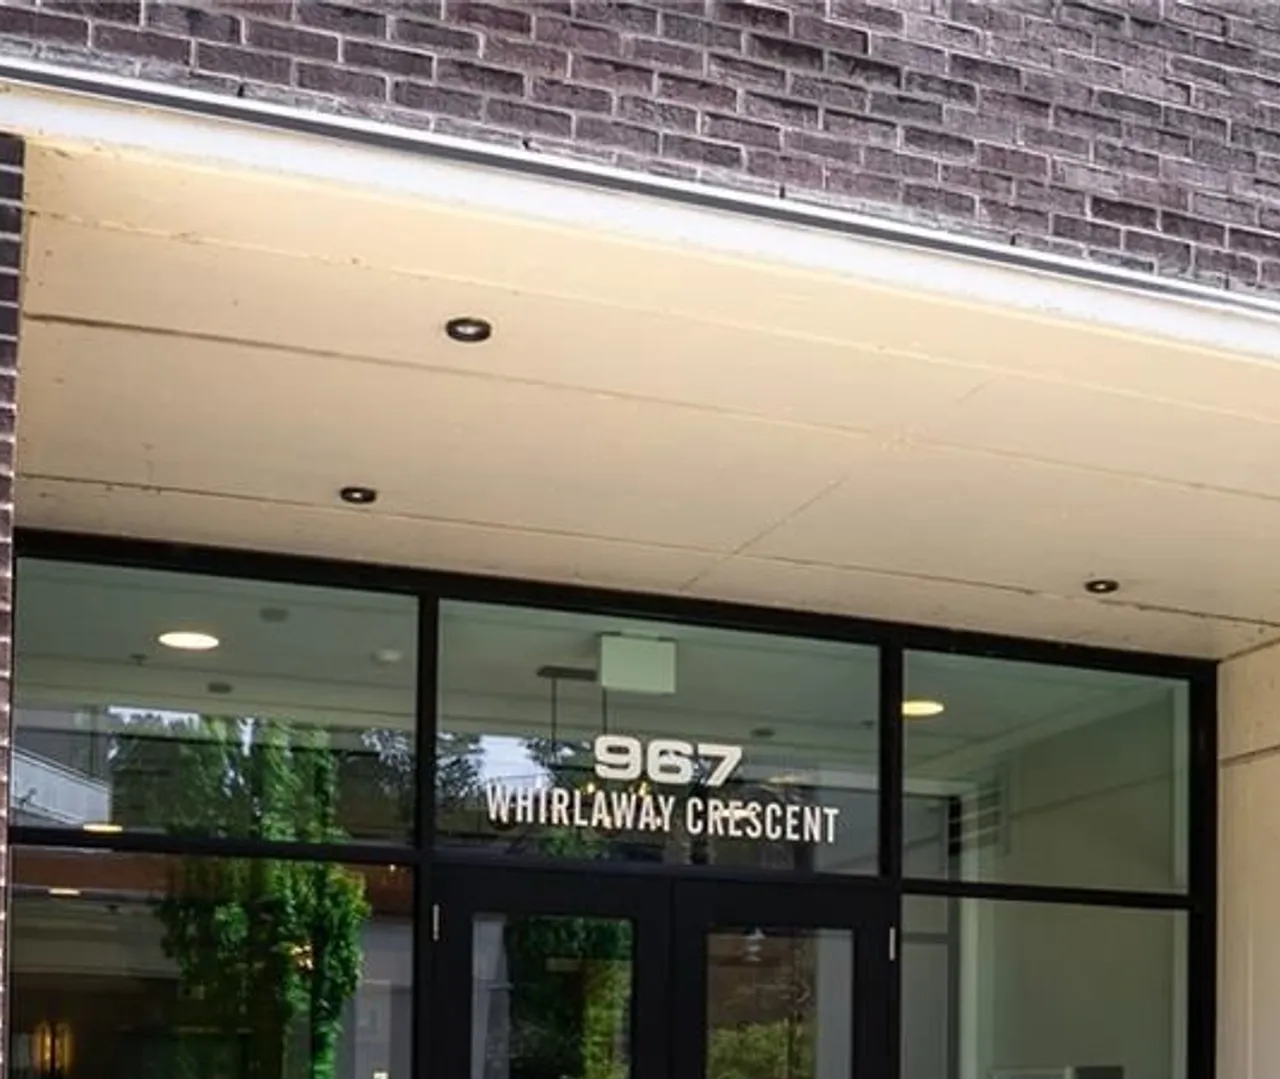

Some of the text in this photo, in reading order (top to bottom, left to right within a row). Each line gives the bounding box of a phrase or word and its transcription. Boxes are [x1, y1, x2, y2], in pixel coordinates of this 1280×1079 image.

[594, 734, 743, 787] 967
[485, 784, 840, 845] WHIRLAWAY CRESCENT
